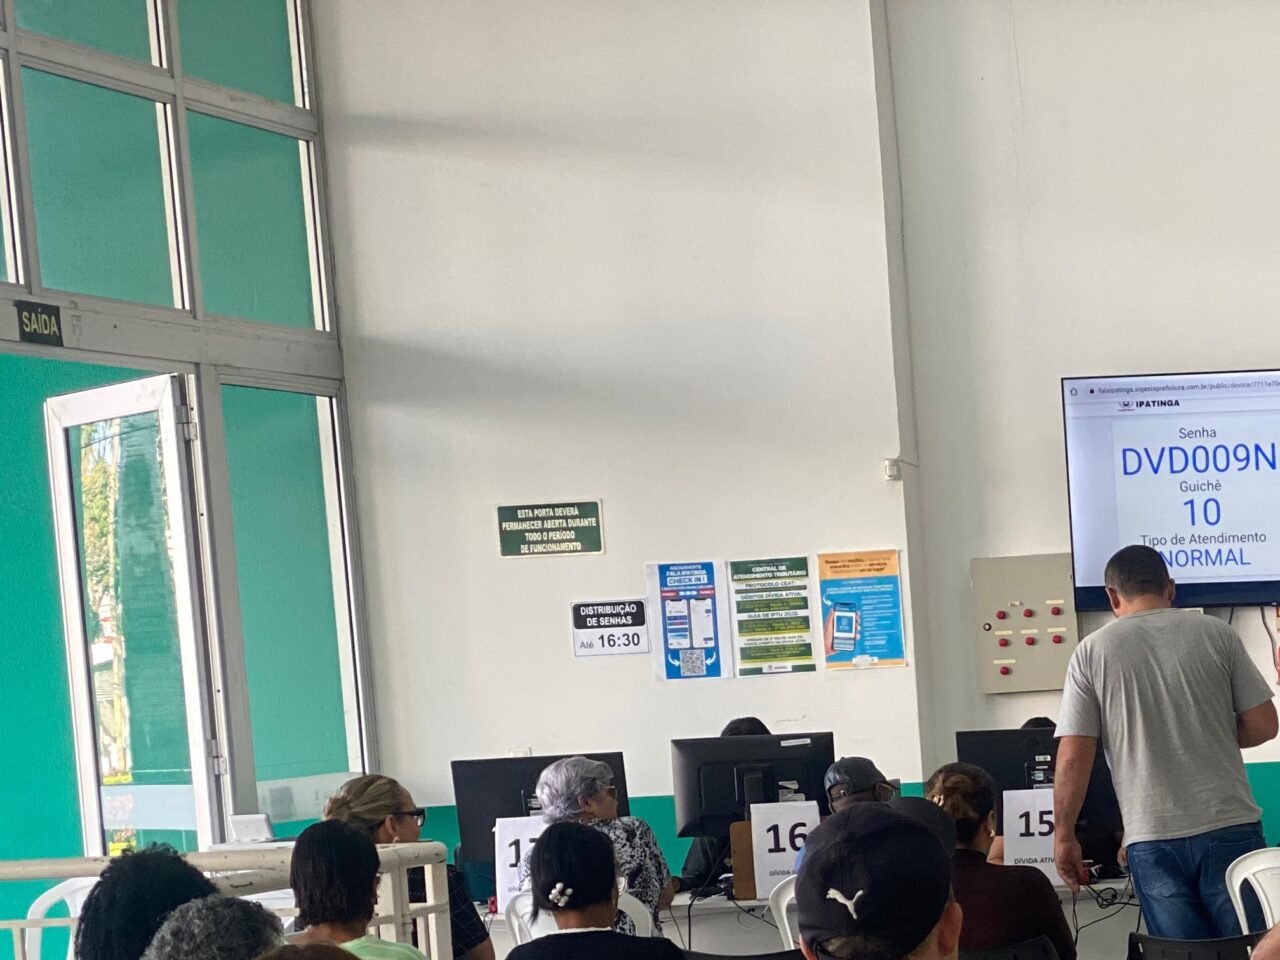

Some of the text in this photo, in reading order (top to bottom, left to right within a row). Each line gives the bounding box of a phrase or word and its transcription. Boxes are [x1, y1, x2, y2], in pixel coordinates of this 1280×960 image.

[22, 308, 60, 336] SAÍDA
[1135, 400, 1180, 409] IPATINGA
[1179, 427, 1216, 439] Senha
[1122, 442, 1277, 476] DVD009N
[1179, 479, 1222, 493] Guichê
[517, 505, 579, 518] ESTA PORTA DEVERÁ
[1183, 498, 1222, 527] 10
[502, 517, 597, 531] PERMANECER ABERTA DURANTE
[524, 529, 576, 541] TODO O PERÍODO
[1141, 531, 1267, 548] Tipo de Atendimento
[520, 541, 582, 553] DE FUNCIONAMENTO
[1159, 548, 1251, 569] NORMAL
[668, 577, 694, 585] CHECK
[733, 572, 773, 580] ATENDIMENTO
[580, 603, 637, 616] DISTRIBUIÇÃO
[587, 615, 632, 626] DE SENHAS
[580, 632, 641, 650] Até 16:30
[1019, 810, 1055, 838] 15
[766, 821, 808, 854] 16
[508, 837, 540, 868] 1
[1014, 857, 1039, 865] DÍVIDA
[769, 869, 791, 877] DÍVIDA
